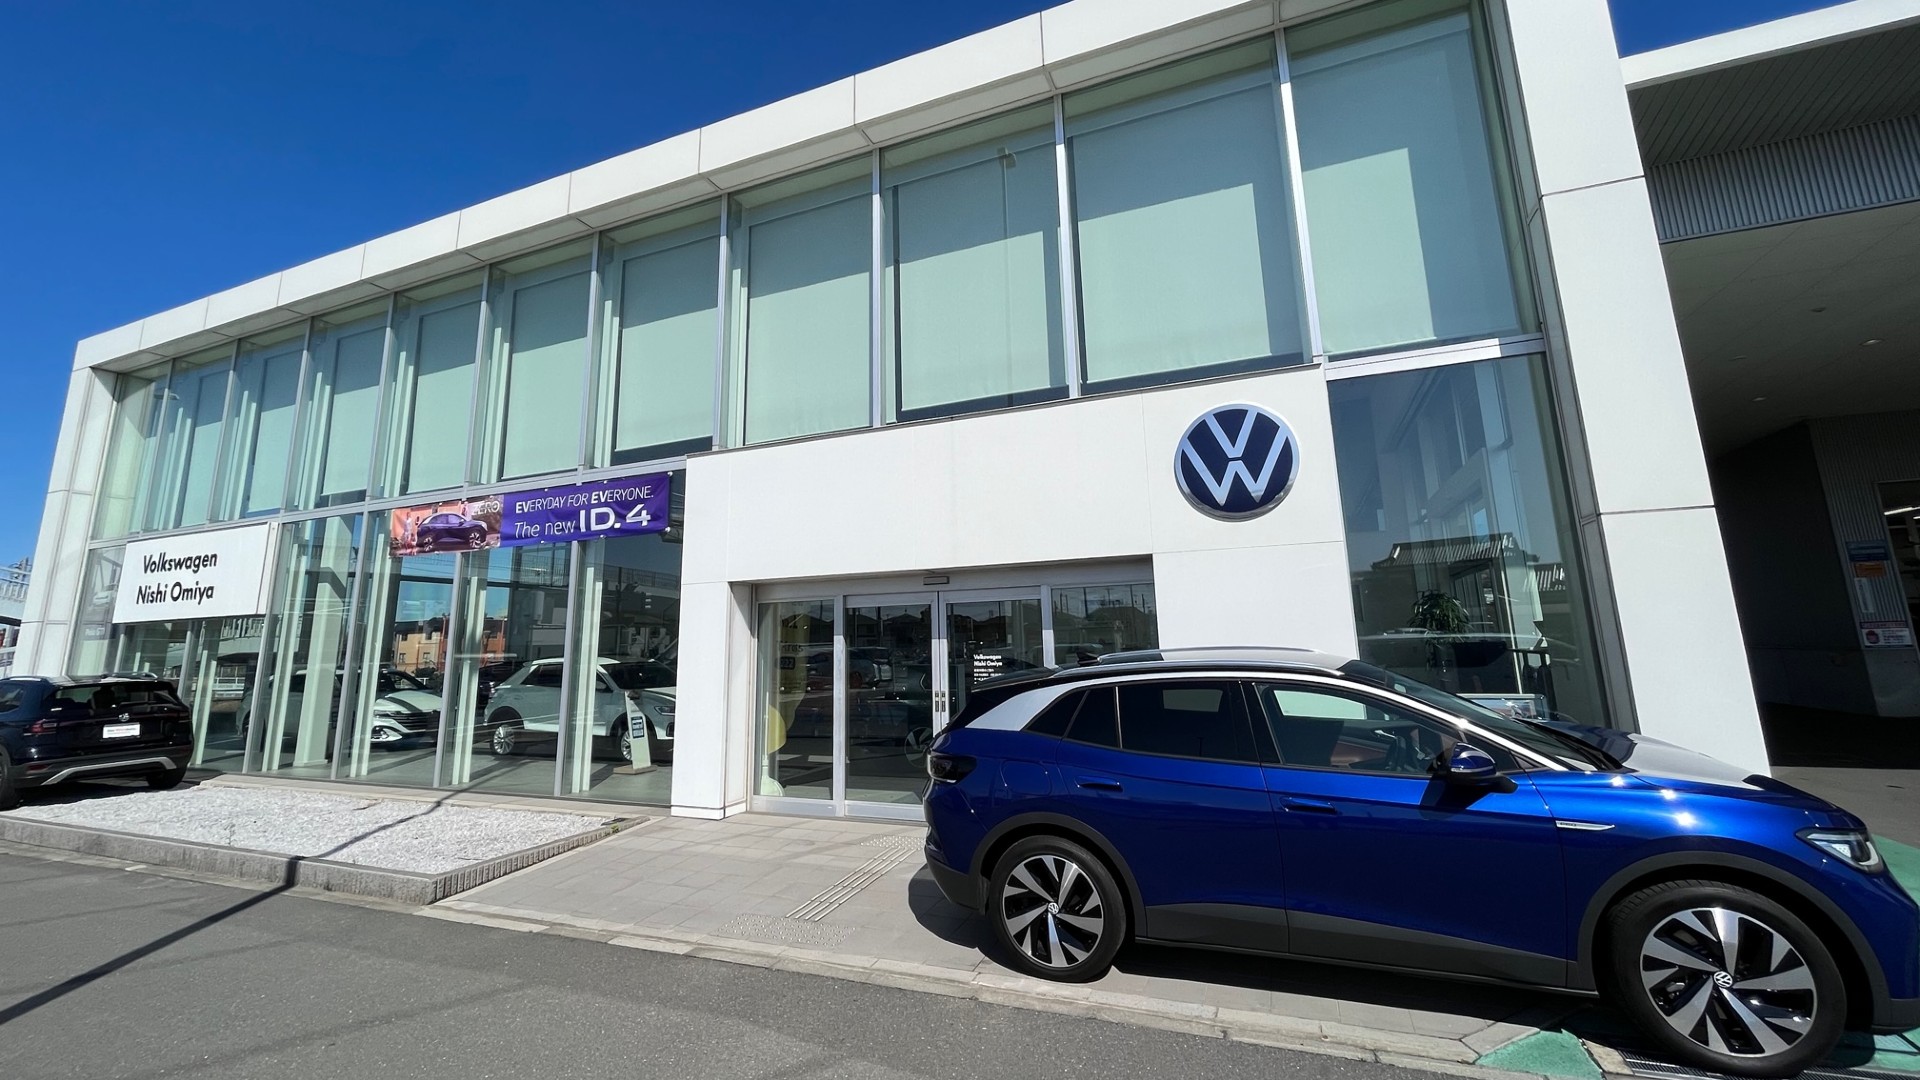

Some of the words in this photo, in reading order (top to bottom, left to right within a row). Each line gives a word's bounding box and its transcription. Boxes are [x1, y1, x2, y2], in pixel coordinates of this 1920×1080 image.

[515, 495, 567, 514] EVERYDAY
[567, 492, 589, 507] FOR
[590, 485, 654, 504] EVERYONE.
[514, 521, 540, 538] The
[544, 519, 576, 536] new
[143, 551, 218, 574] Volkswagen
[136, 583, 168, 605] Nishi
[170, 581, 215, 605] Omiya
